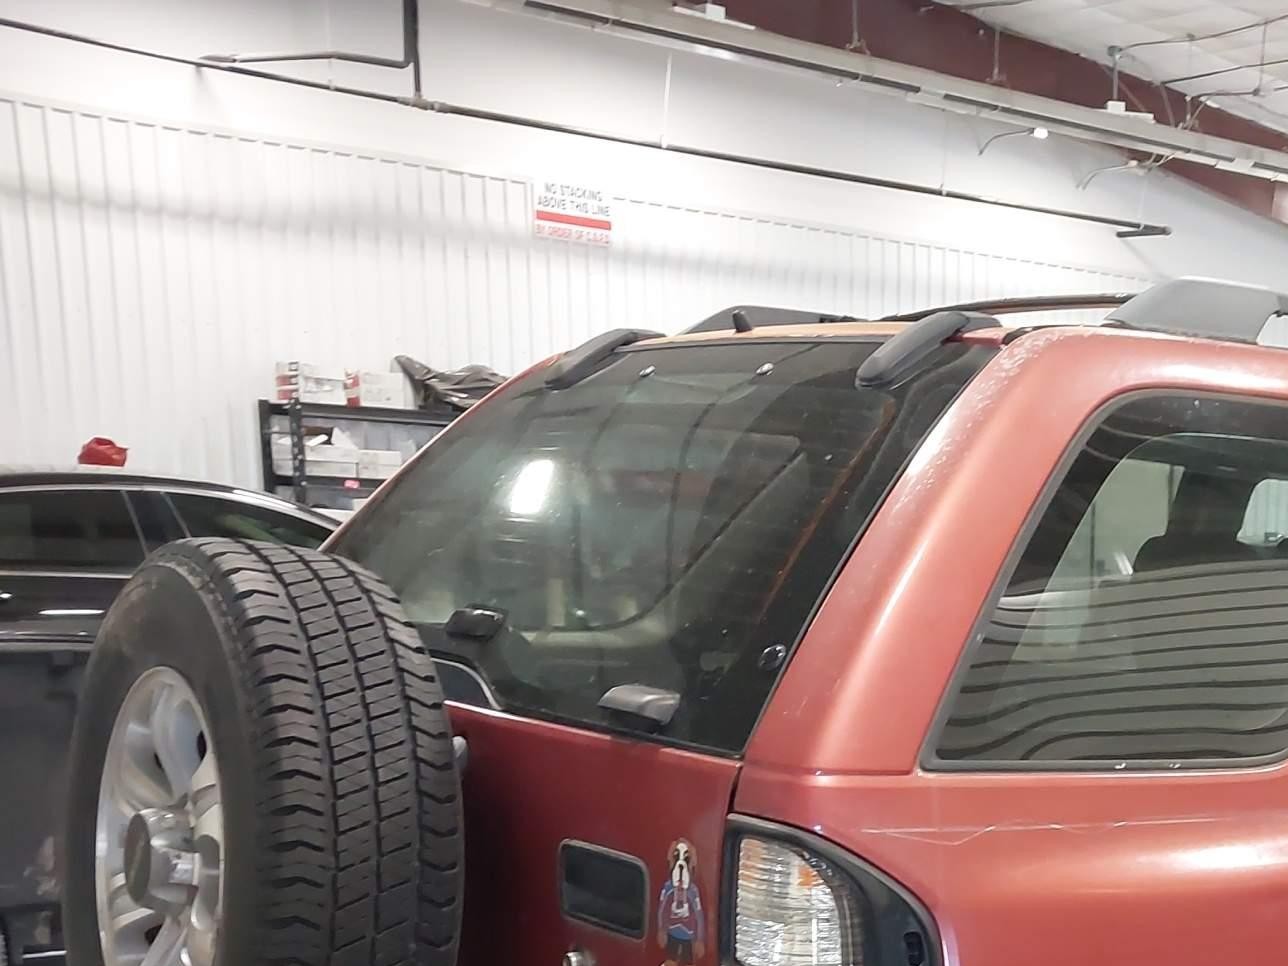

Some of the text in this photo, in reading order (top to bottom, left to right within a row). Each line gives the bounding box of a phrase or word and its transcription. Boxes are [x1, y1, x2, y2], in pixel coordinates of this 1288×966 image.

[544, 182, 603, 202] NO STACKING
[537, 194, 611, 217] ABOVE THIS LINE
